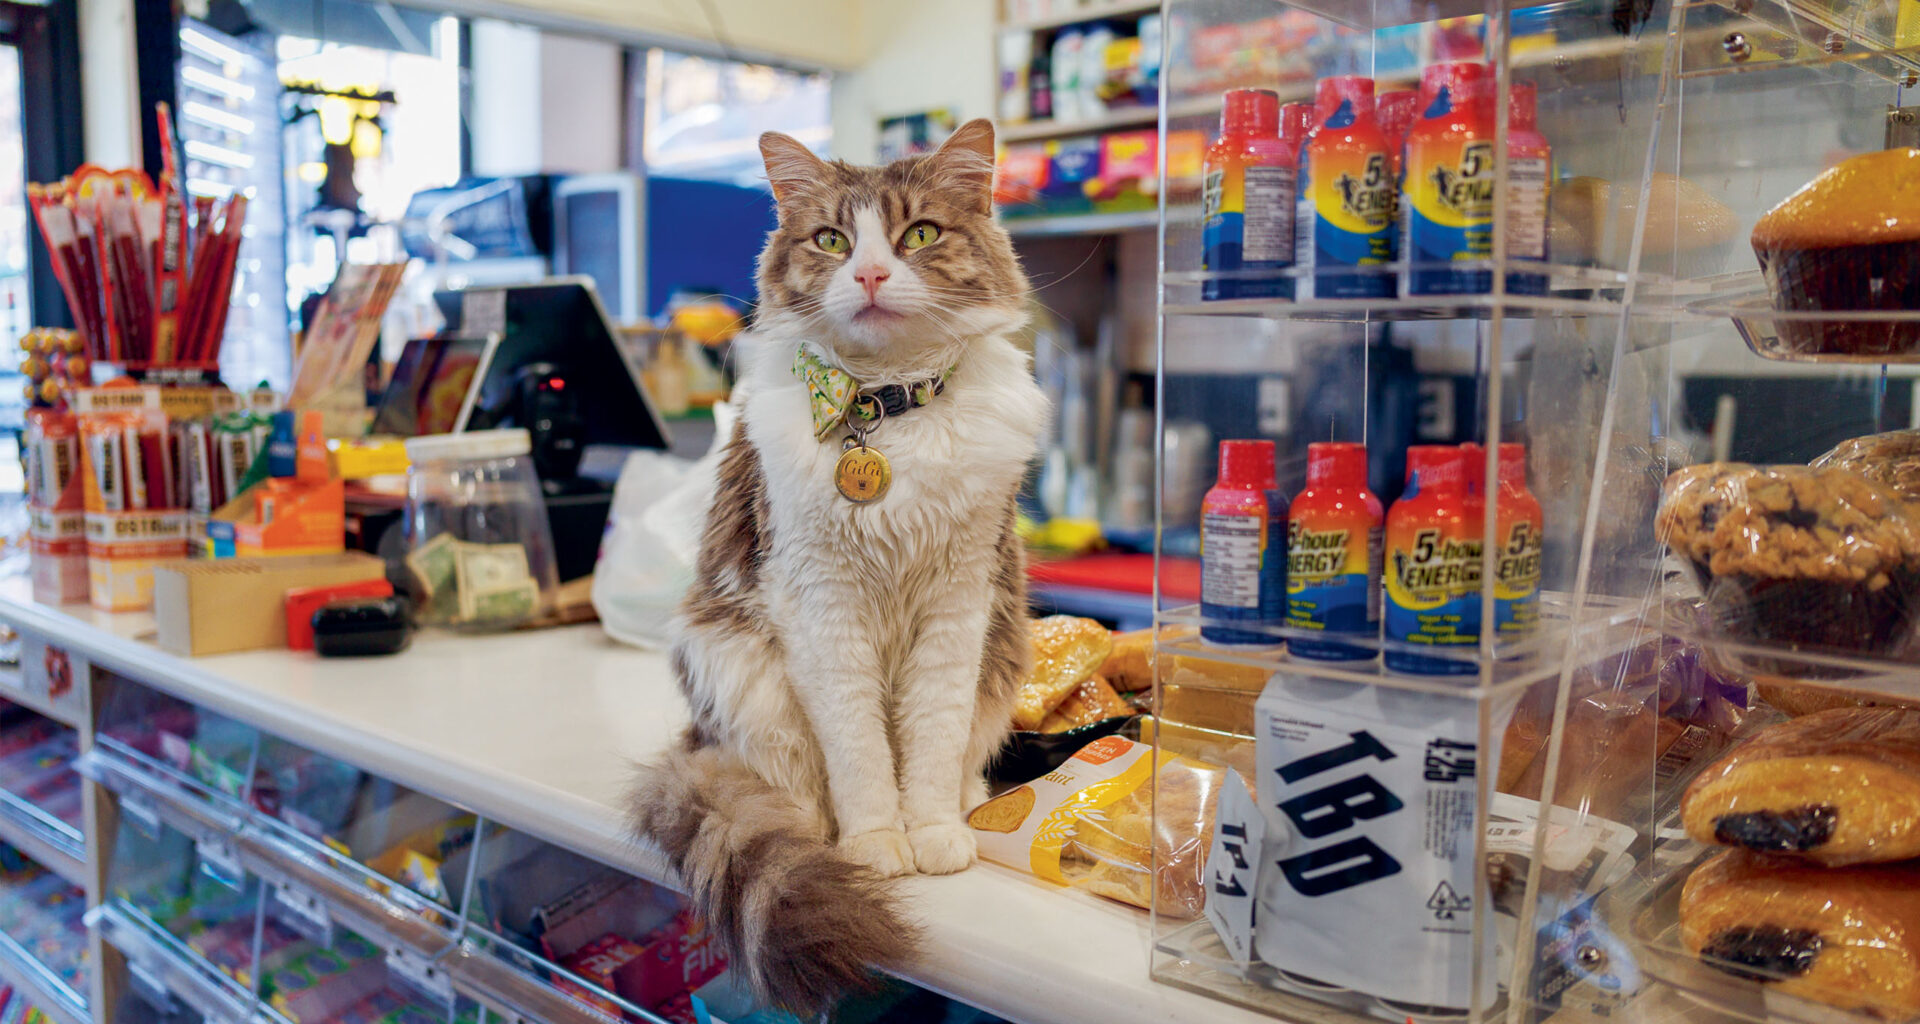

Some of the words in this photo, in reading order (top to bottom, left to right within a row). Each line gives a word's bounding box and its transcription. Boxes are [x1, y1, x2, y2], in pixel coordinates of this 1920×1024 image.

[844, 459, 881, 477] GiGi
[1287, 551, 1342, 574] NERGY
[1404, 560, 1483, 589] ENERG
[1500, 552, 1541, 581] ENER
[1274, 729, 1405, 897] TBD
